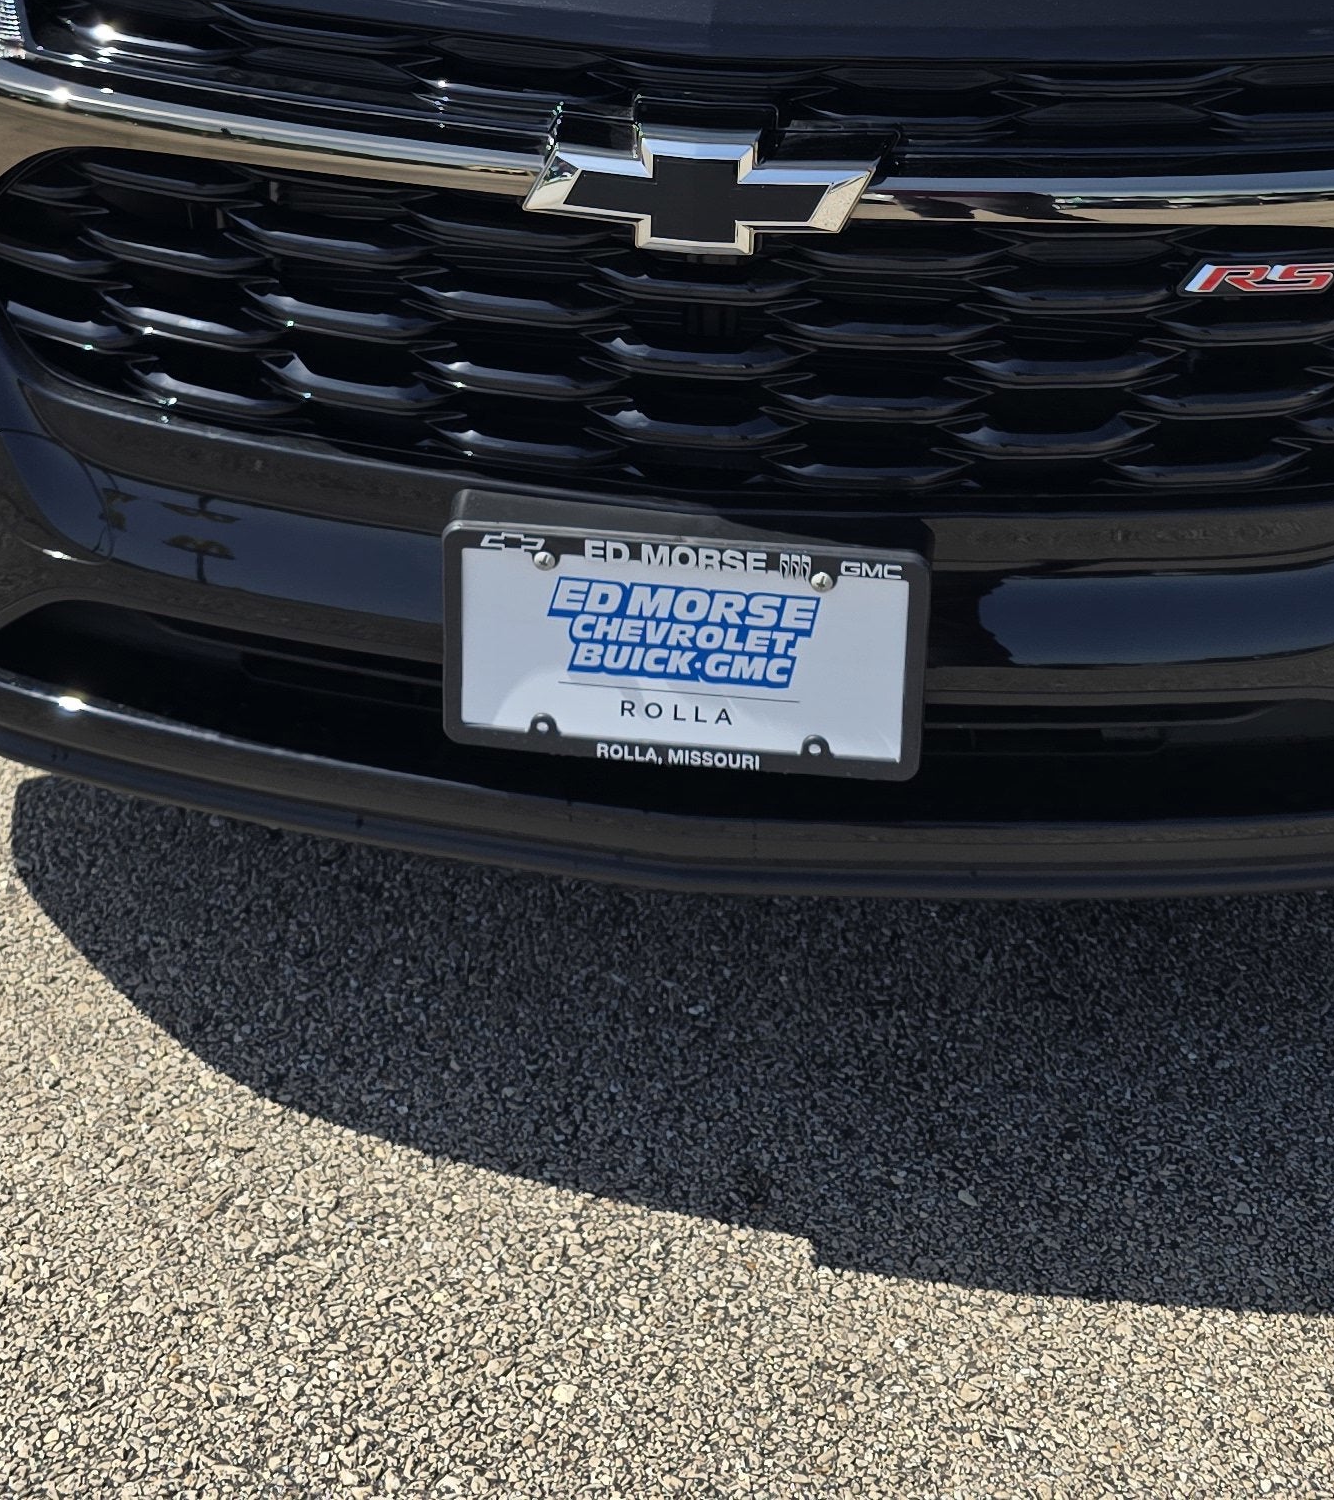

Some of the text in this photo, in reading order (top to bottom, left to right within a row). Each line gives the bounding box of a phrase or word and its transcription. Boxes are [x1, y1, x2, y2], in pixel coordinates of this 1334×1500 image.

[584, 539, 903, 580] ED MORSE GMC
[552, 579, 817, 630] ED MORSE
[621, 700, 732, 726] ROLLA
[596, 743, 760, 771] ROLLA, MISSOURI
